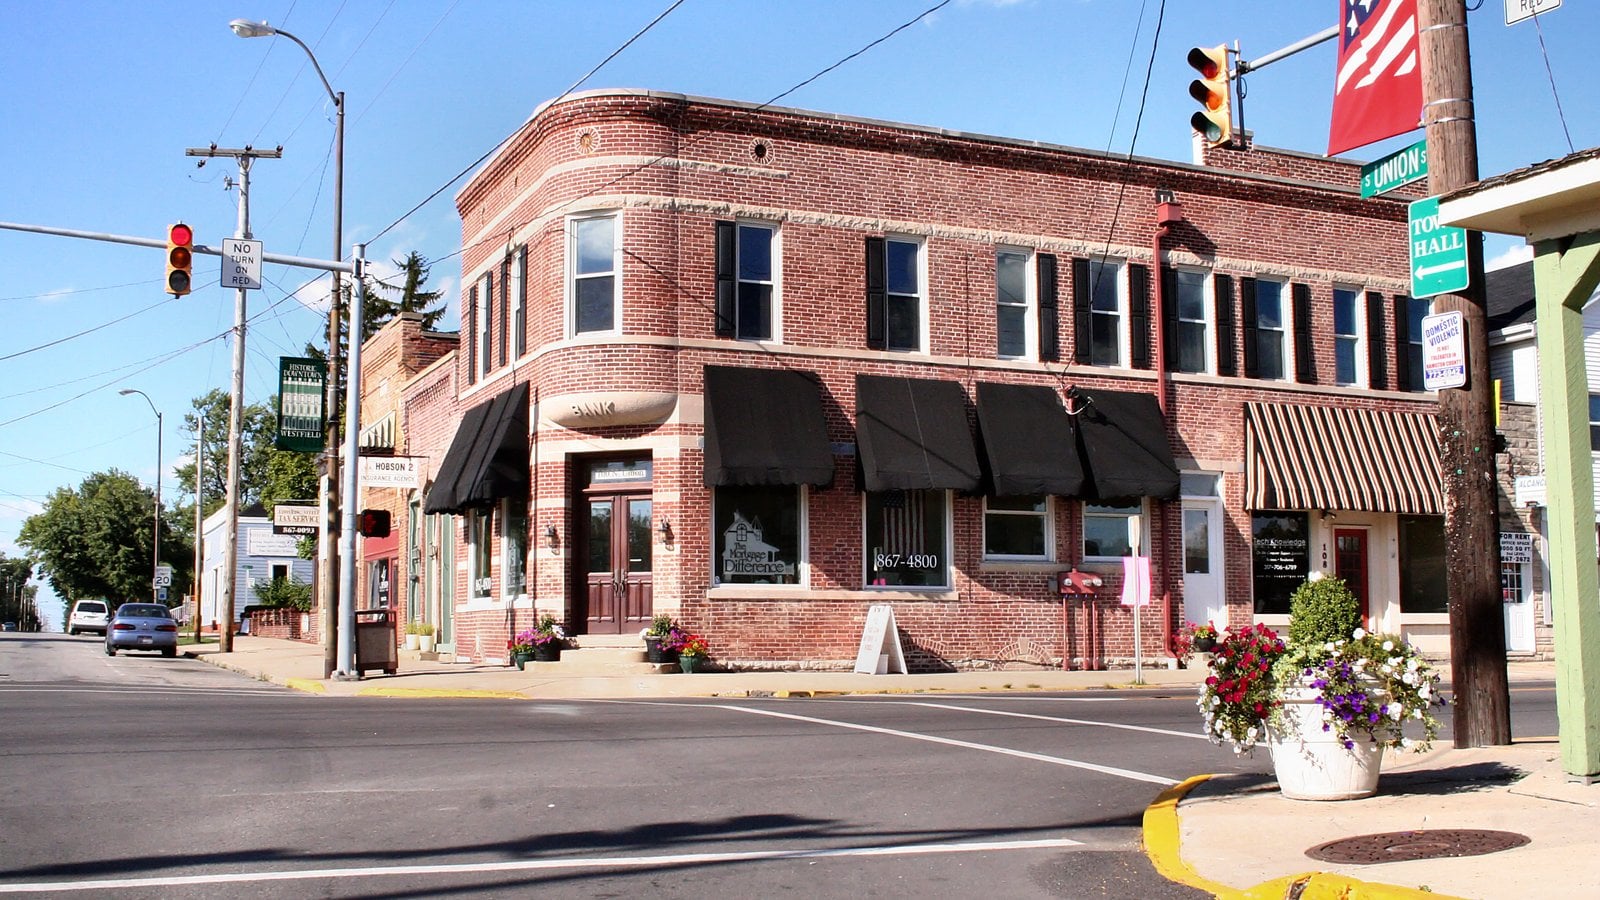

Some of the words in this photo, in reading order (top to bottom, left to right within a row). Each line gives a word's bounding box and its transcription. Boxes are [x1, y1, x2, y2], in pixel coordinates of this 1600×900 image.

[1365, 174, 1371, 187] S
[1374, 148, 1419, 188] UNION
[1411, 214, 1446, 236] TO
[233, 244, 251, 253] NO
[1414, 232, 1463, 258] HALL
[231, 255, 254, 264] TURN
[235, 266, 248, 274] ON
[232, 276, 250, 285] RED
[1425, 316, 1458, 337] DOMESTIC
[1429, 326, 1459, 347] VIOLENCE
[289, 363, 317, 371] HISTORIC
[283, 369, 323, 378] DOWNTOWN
[570, 401, 616, 417] BANK
[280, 430, 322, 438] WESTFIELD
[375, 462, 406, 471] HOBSON
[292, 514, 320, 523] SERVICE
[734, 542, 746, 550] The
[730, 549, 767, 562] Mortgage
[876, 553, 937, 569] 867-4800
[724, 559, 785, 573] Difference
[156, 576, 169, 584] 20
